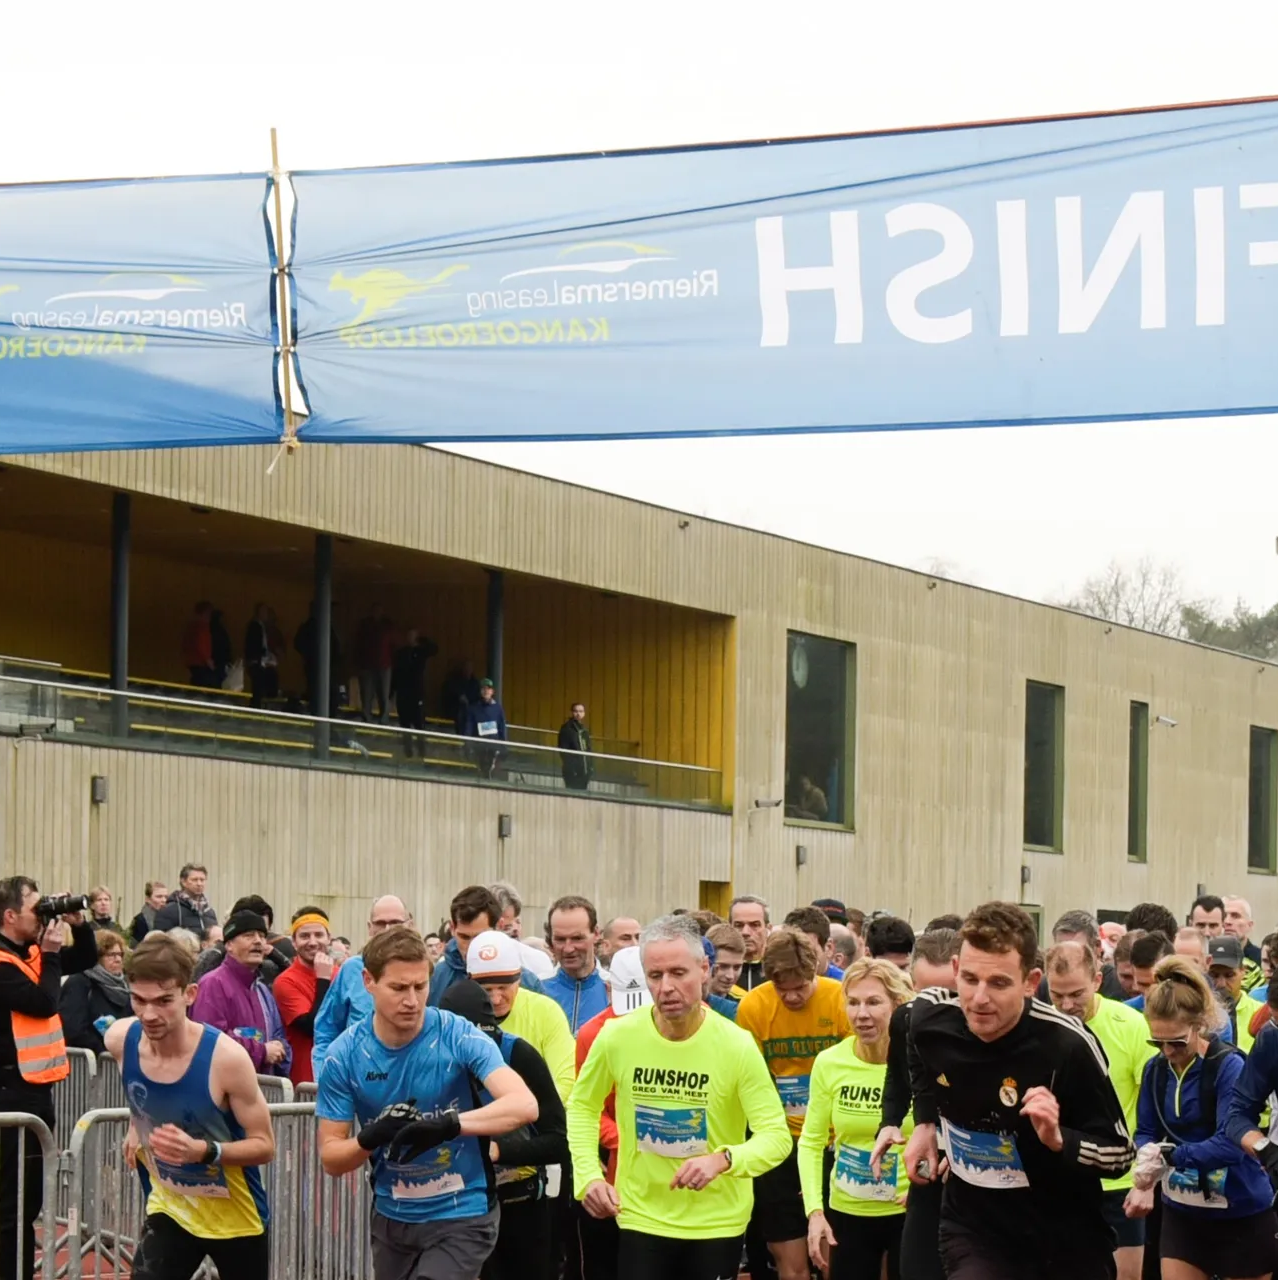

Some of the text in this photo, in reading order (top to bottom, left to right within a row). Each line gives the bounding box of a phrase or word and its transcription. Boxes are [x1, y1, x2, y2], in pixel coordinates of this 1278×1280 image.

[632, 1067, 709, 1090] RUNSHOP
[632, 1085, 657, 1093] GREG
[661, 1087, 680, 1095] VAN
[840, 1085, 881, 1102] RUNS
